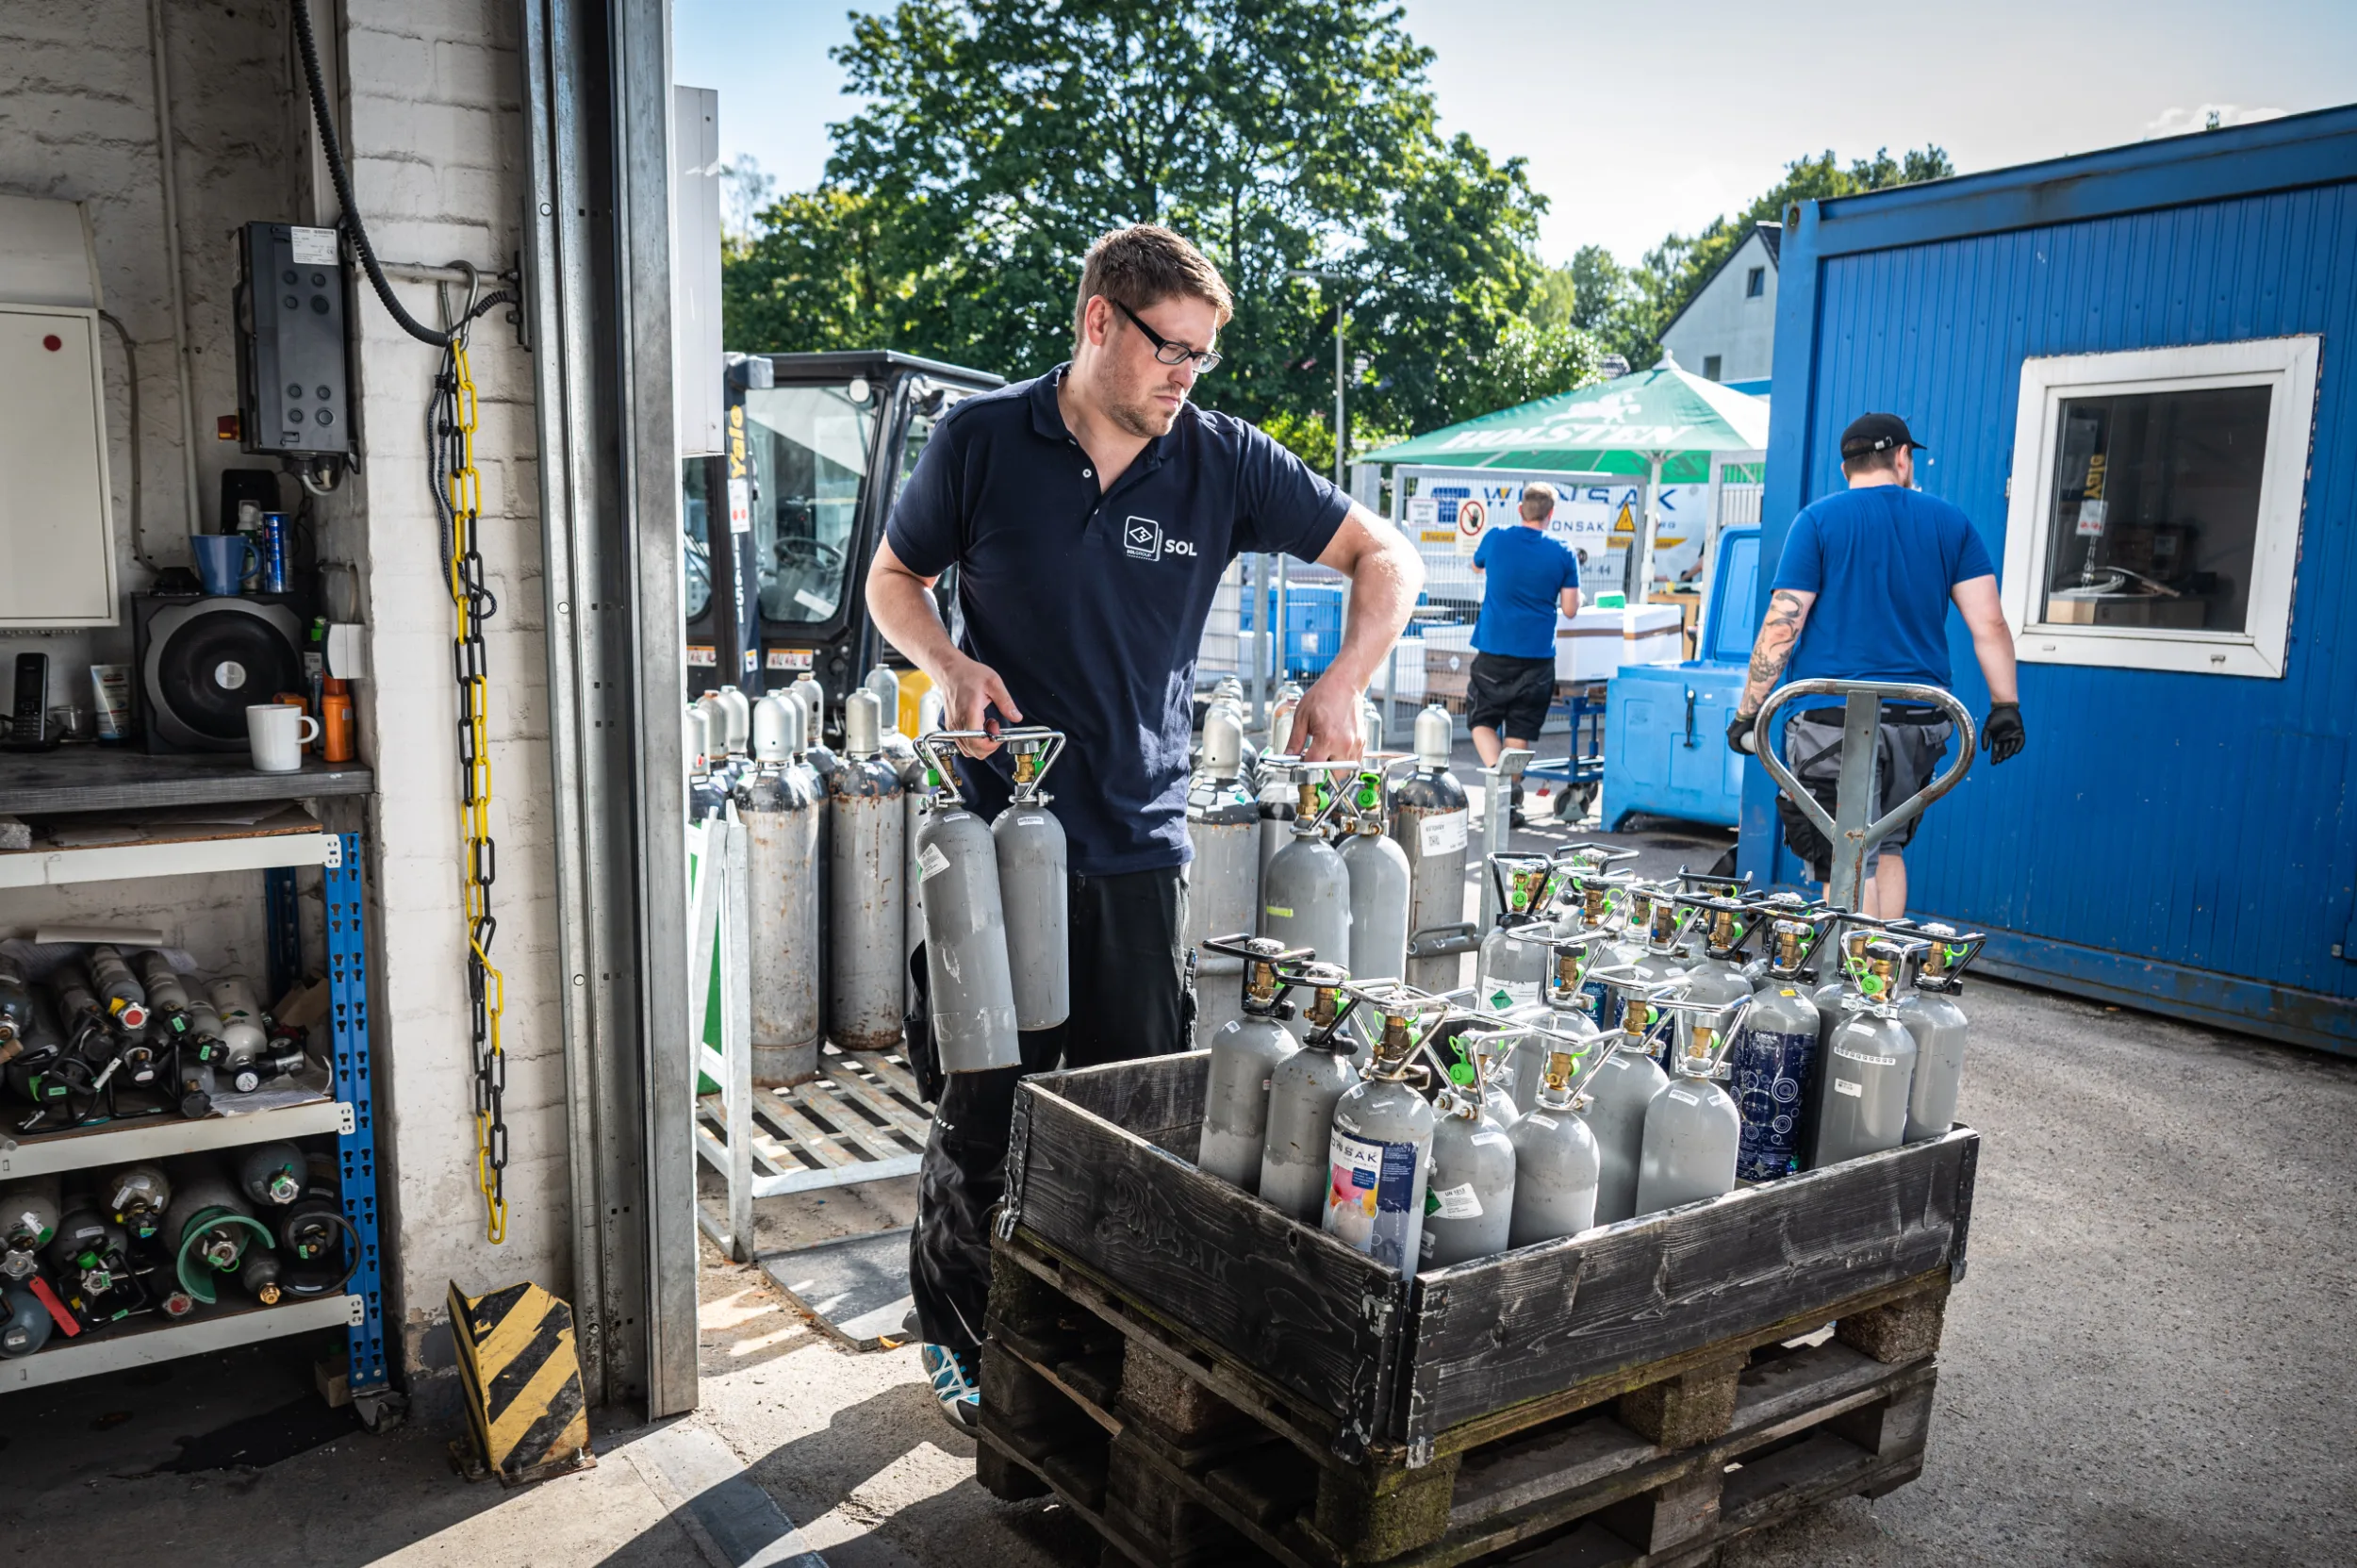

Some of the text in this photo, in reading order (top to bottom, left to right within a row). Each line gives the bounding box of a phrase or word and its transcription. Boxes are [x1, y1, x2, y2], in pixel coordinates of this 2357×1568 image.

[728, 404, 747, 479] Yale
[1439, 425, 1694, 450] HOLSTEN
[1552, 520, 1606, 532] ONSAK
[1164, 538, 1197, 556] SOL
